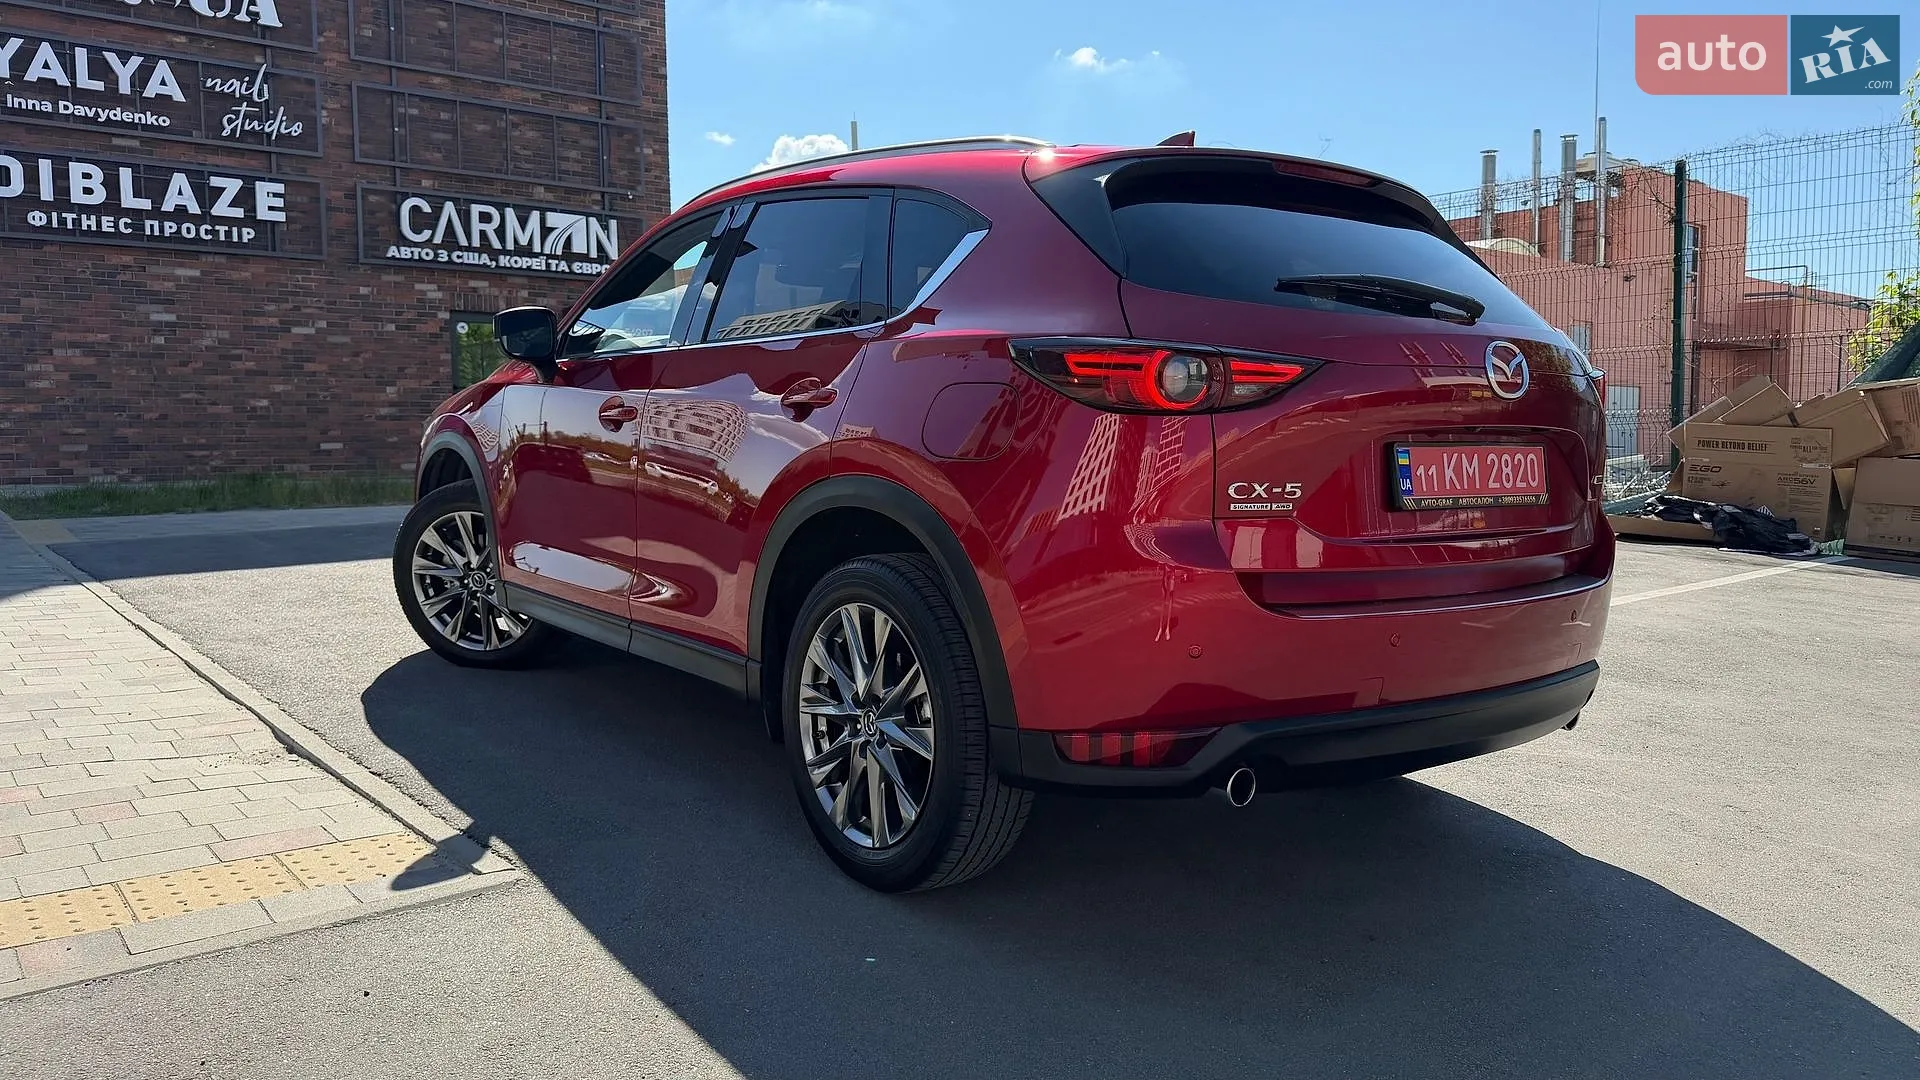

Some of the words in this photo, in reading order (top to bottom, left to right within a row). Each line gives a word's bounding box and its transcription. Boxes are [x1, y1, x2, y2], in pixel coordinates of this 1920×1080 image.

[201, 63, 269, 103] nail
[6, 93, 53, 113] Inna
[58, 100, 171, 127] Davydenko
[221, 101, 304, 140] studio
[27, 210, 133, 234] ФІТНЕС
[144, 219, 256, 243] ПРОСТІР
[386, 245, 434, 260] АВТО
[451, 252, 496, 268] США,
[498, 254, 546, 270] КОРЕЇ
[548, 259, 570, 273] ТА
[1697, 440, 1720, 449] POWER
[1415, 464, 1438, 492] 11
[1442, 453, 1480, 490] KM
[1486, 453, 1539, 488] 2820
[1688, 464, 1722, 473] EGO
[1228, 482, 1302, 499] CX-5
[1400, 478, 1412, 491] UA
[1458, 497, 1494, 505] АВТОСАЛОН
